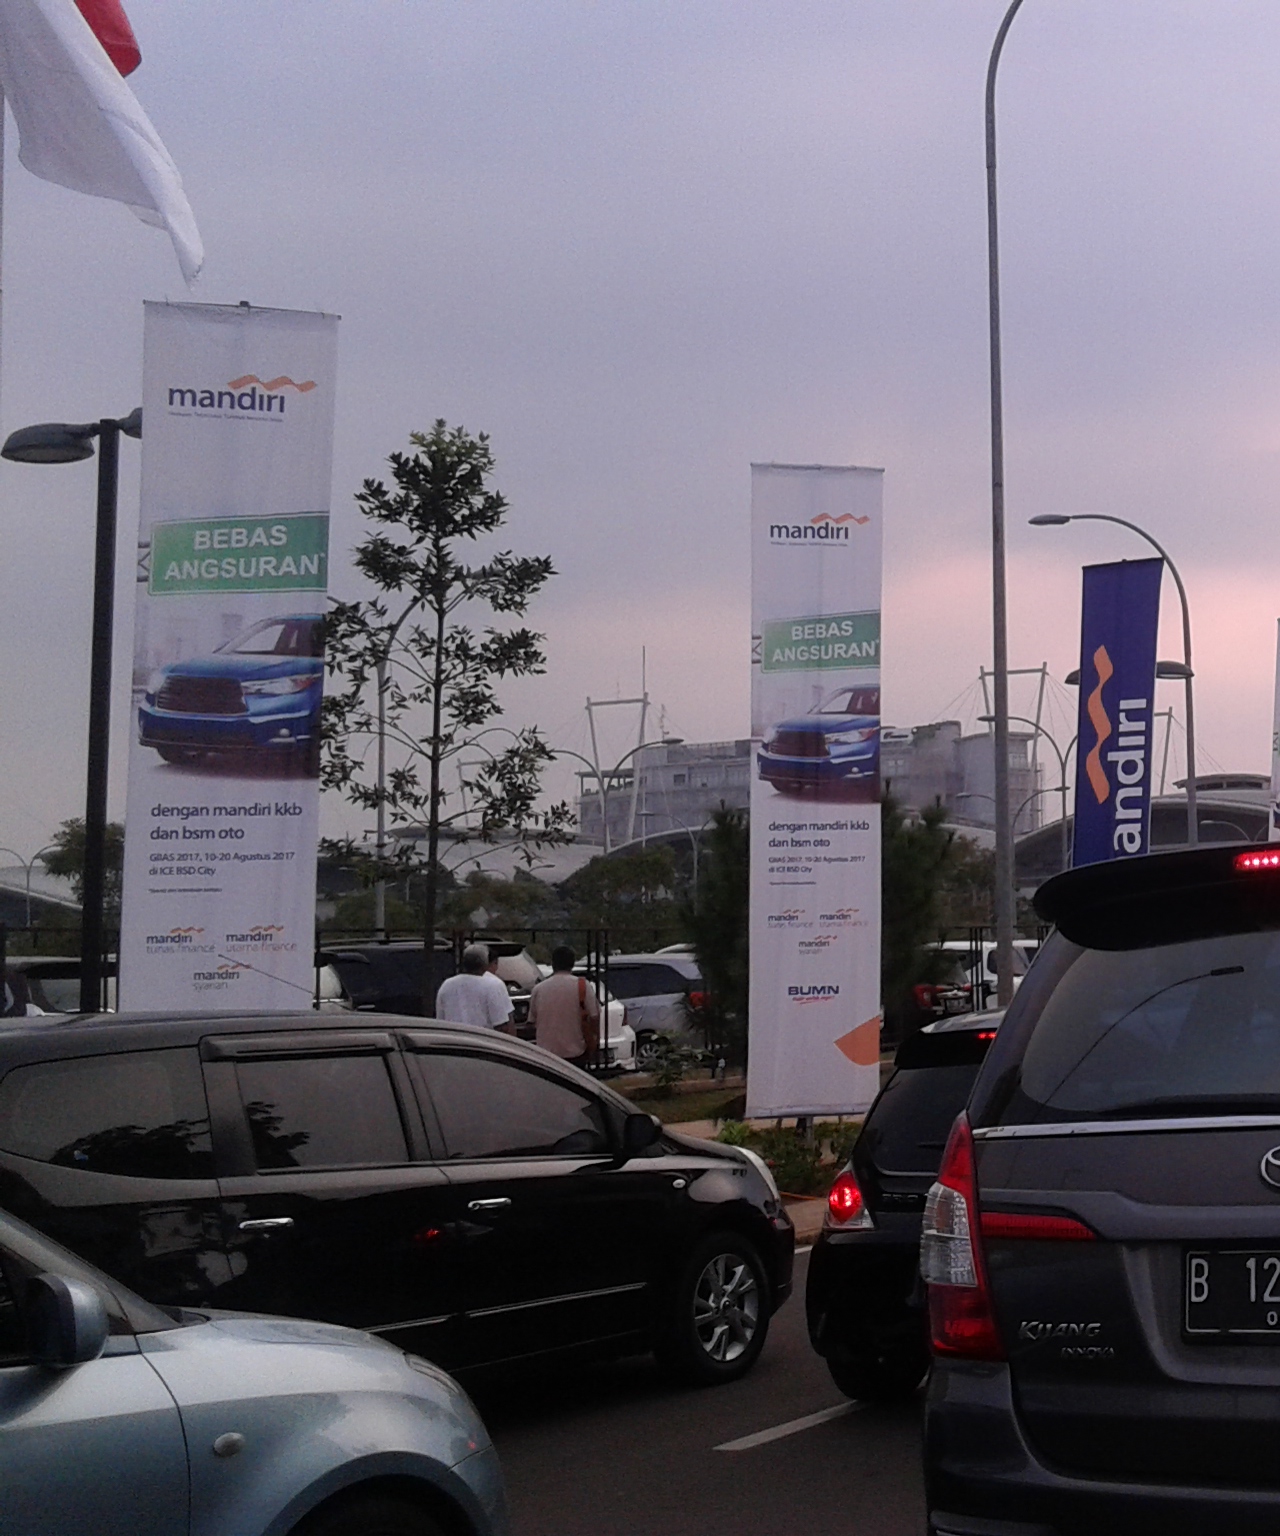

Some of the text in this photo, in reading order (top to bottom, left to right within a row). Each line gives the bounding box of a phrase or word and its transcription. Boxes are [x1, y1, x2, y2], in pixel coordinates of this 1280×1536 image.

[168, 386, 285, 413] mandiri
[193, 524, 288, 550] BEBAS
[770, 522, 849, 540] mandiri
[791, 620, 853, 641] BEBAS
[1107, 697, 1147, 854] andiri
[151, 802, 303, 820] dengan mandiri kkb
[150, 826, 245, 840] dan bsm oto
[768, 819, 870, 834] dengan mandiri kkb
[768, 837, 831, 848] dan bsm oto
[232, 852, 271, 863] Agustus
[273, 851, 295, 860] 2017
[149, 866, 216, 877] di ICE BSD City
[819, 913, 851, 921] mandiri
[146, 932, 193, 943] mandiri
[226, 931, 273, 942] mandiri
[798, 939, 830, 947] mandiri
[193, 969, 240, 980] mandiri
[788, 985, 840, 996] BUMN
[1190, 1258, 1209, 1303] B
